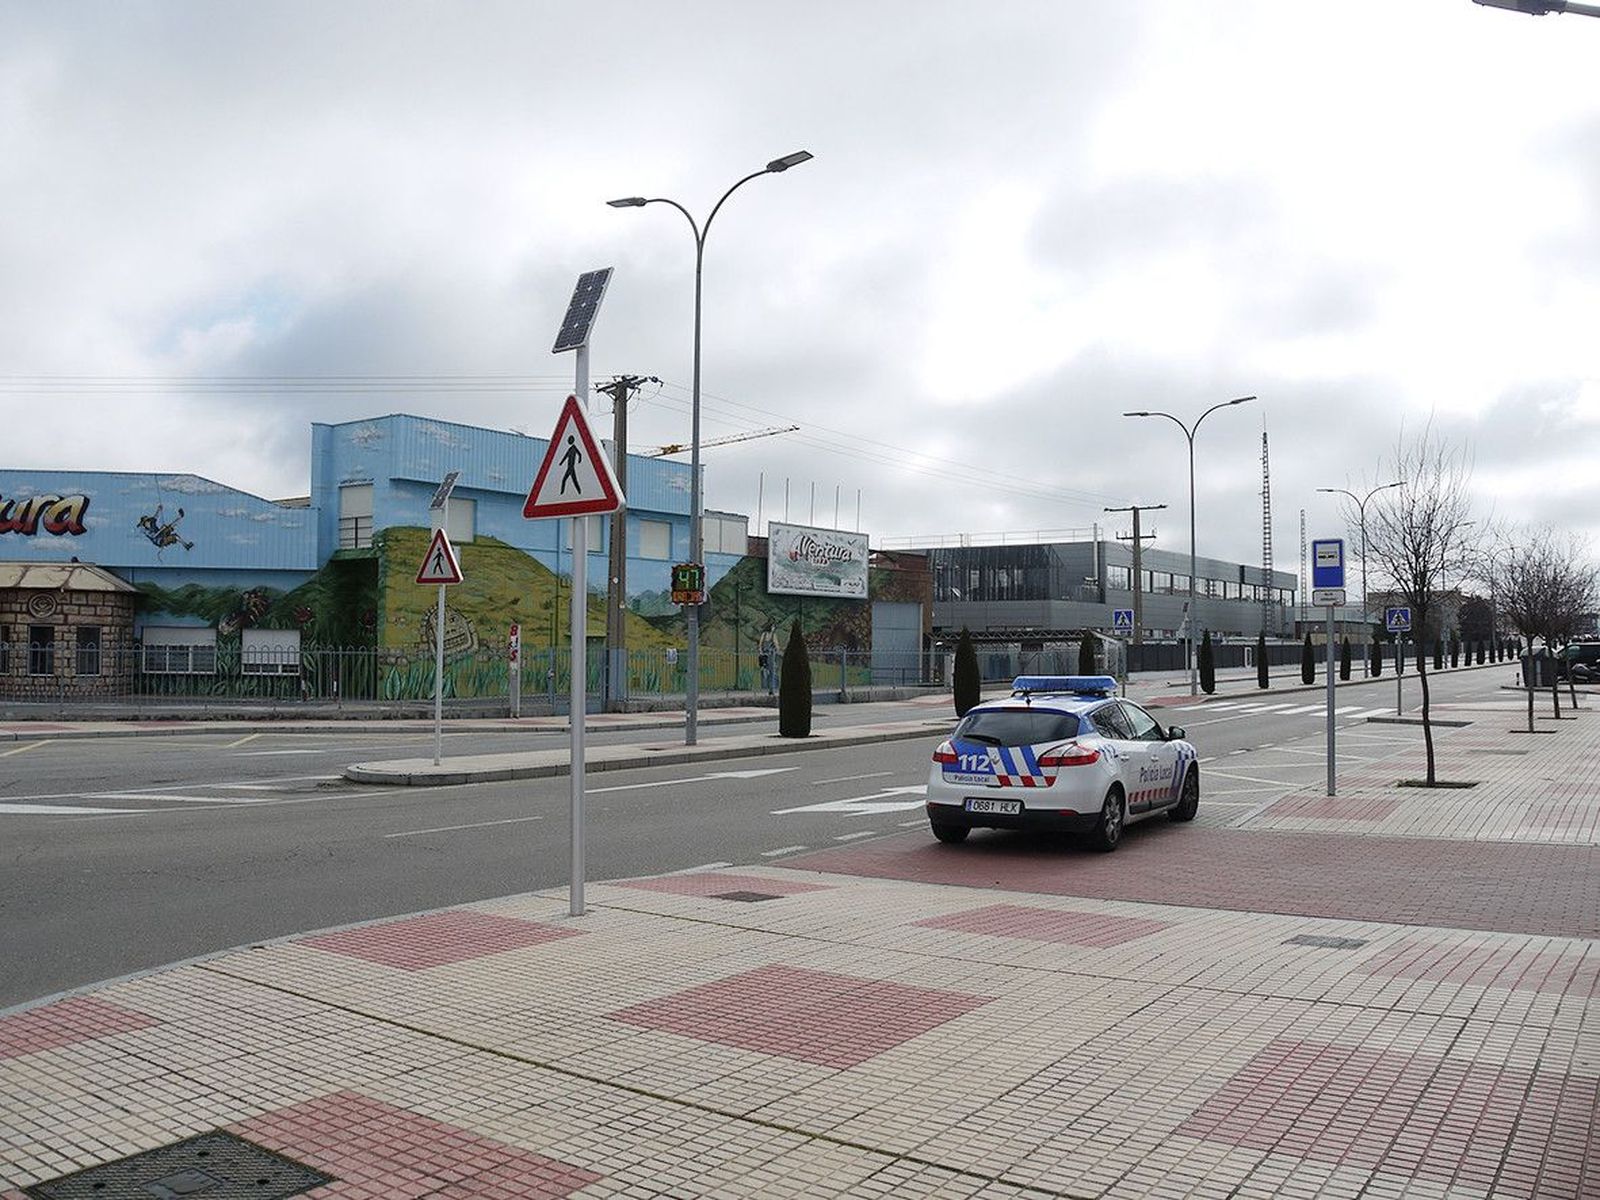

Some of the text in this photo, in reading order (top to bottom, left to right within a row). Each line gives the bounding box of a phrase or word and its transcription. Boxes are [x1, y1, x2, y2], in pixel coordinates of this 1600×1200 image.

[678, 569, 700, 589] 47
[958, 754, 991, 772] 112
[973, 775, 991, 783] Local
[973, 801, 994, 812] 0681
